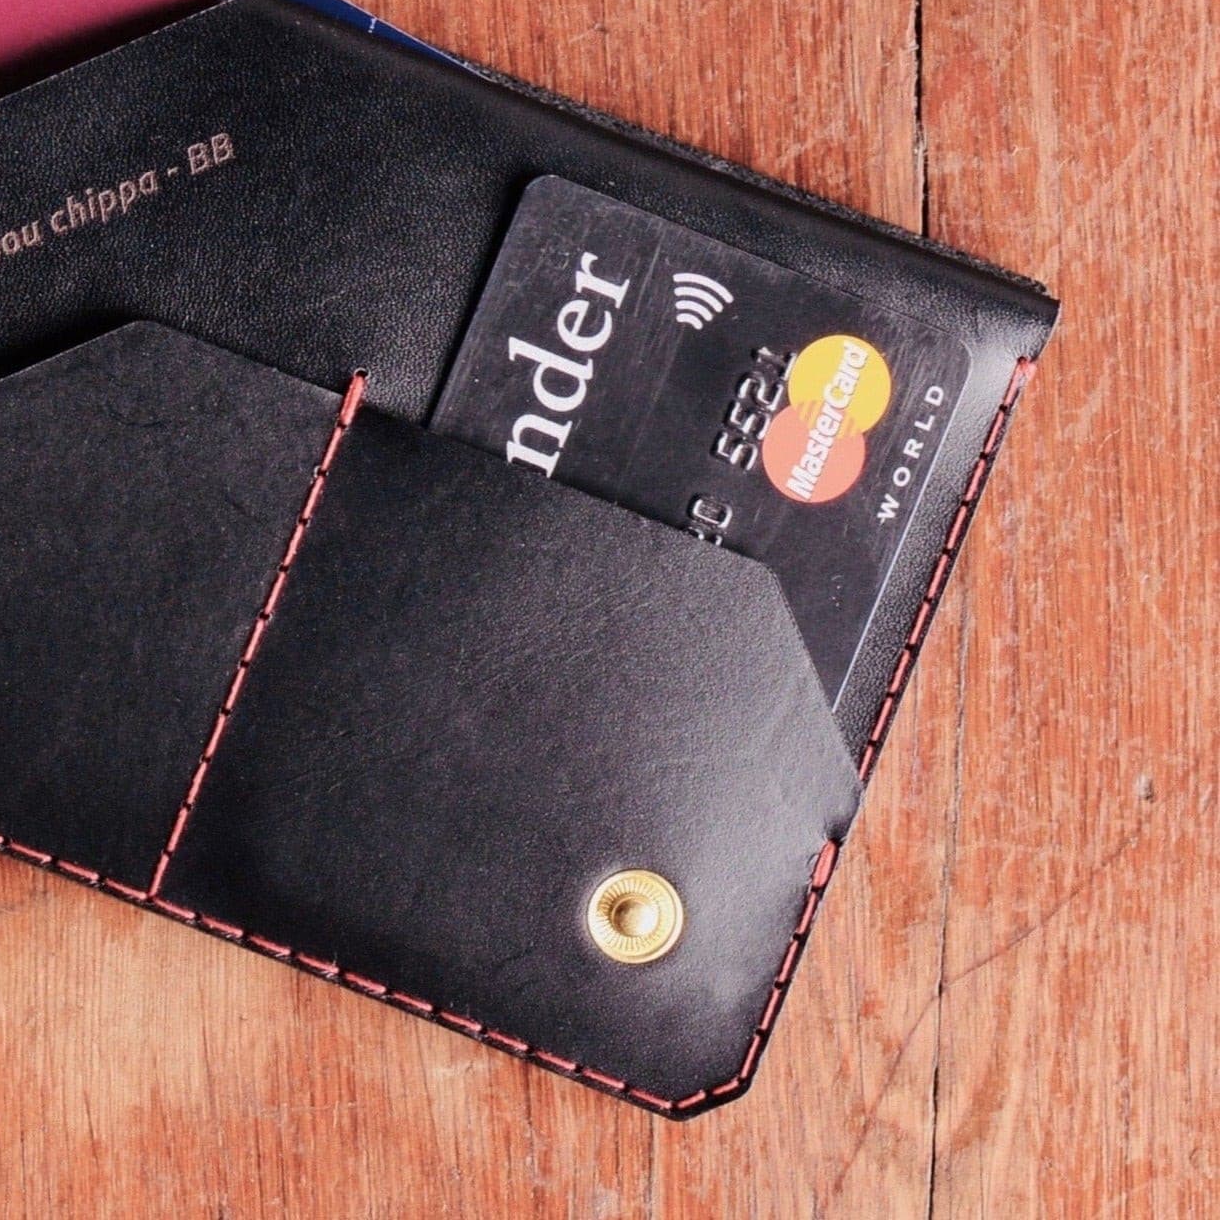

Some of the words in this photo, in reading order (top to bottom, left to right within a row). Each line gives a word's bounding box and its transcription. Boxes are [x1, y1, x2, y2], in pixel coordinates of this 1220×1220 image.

[50, 170, 159, 233] chippa
[187, 132, 235, 175] BB
[506, 251, 630, 478] nder
[712, 345, 797, 472] 5521
[785, 339, 869, 501] MasterCard
[876, 384, 945, 525] WORLD
